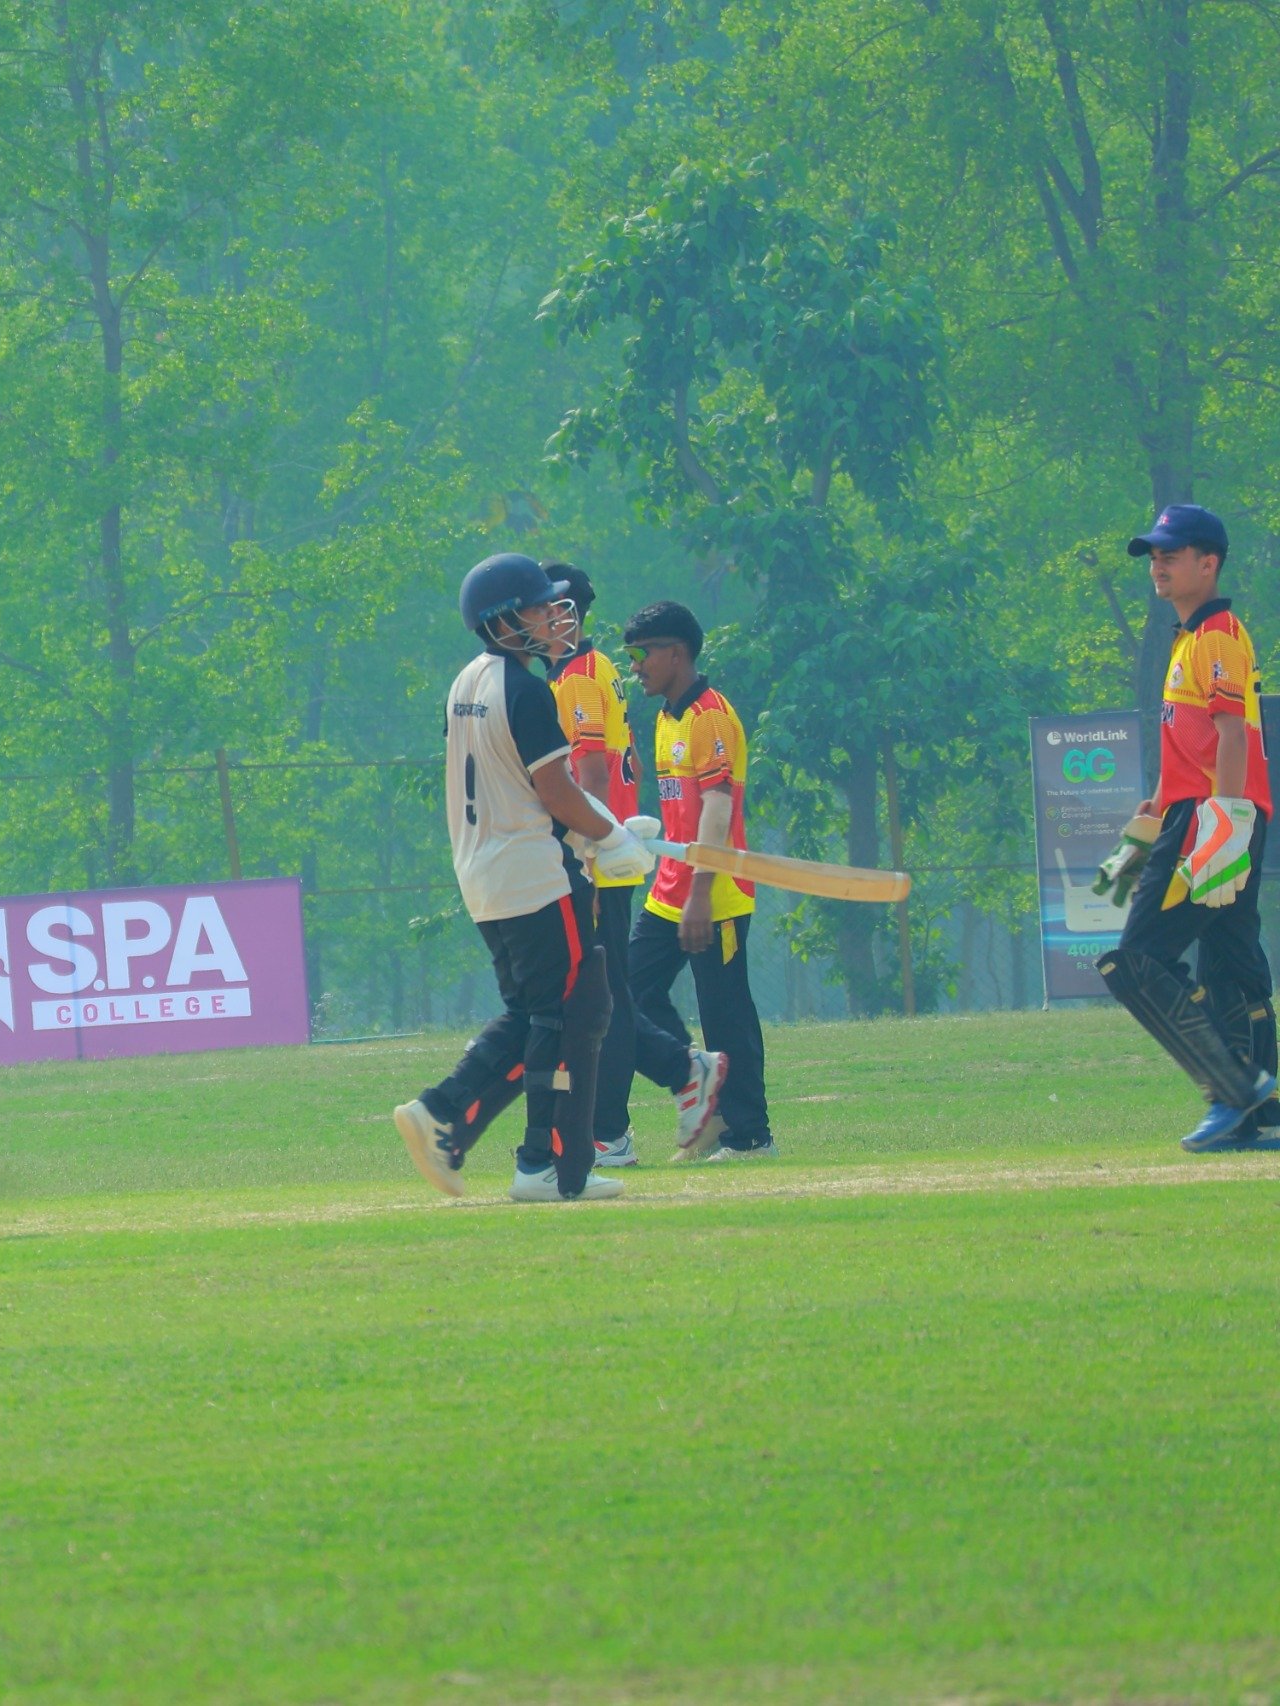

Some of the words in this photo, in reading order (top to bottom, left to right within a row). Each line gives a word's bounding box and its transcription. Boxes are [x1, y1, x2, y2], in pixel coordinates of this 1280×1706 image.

[1063, 729, 1128, 743] WorldLink
[1062, 747, 1116, 784] 6G
[26, 896, 248, 994] S.P.A
[56, 995, 226, 1025] COLLEGE
